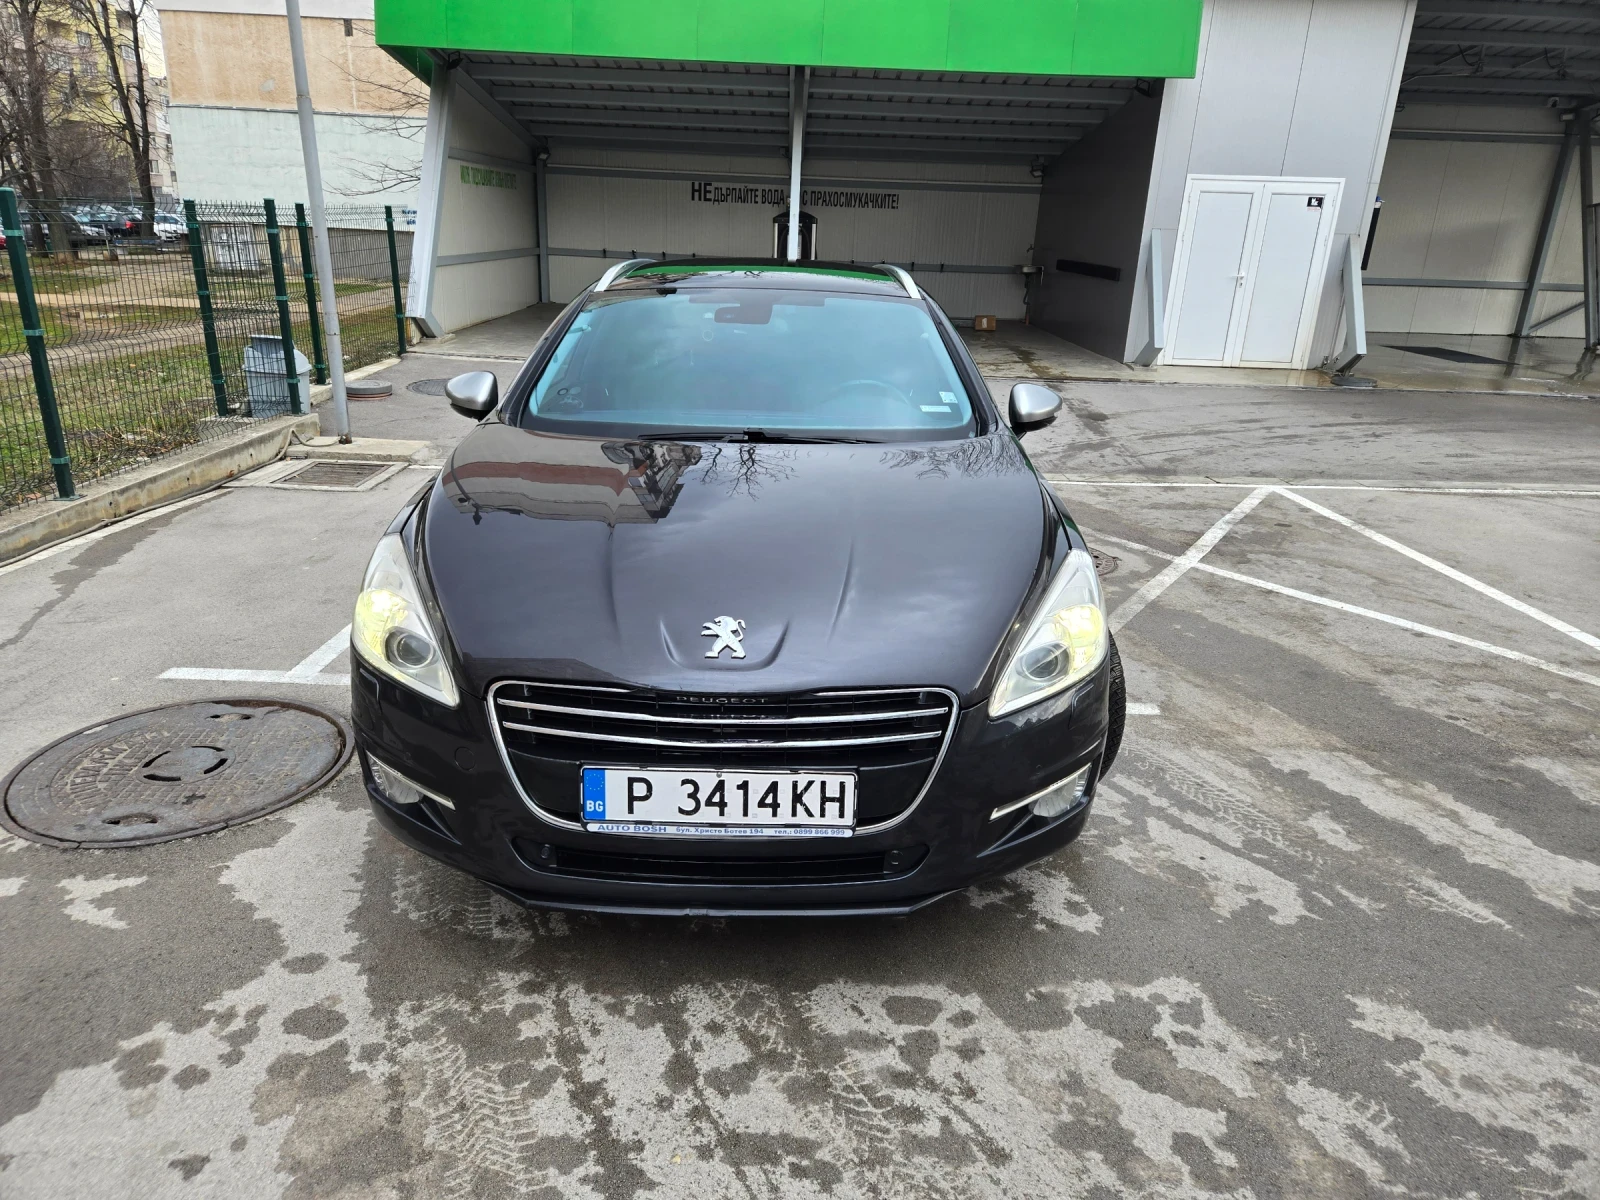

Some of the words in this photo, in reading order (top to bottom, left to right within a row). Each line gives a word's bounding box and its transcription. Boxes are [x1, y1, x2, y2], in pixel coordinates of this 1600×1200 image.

[691, 182, 712, 201] НЕ
[713, 185, 758, 205] ДЪРПАЙТЕ
[761, 189, 785, 207] ВОДА
[802, 190, 808, 205] С
[810, 190, 900, 209] ПРАХОСМУКАЧКИТЕ!
[676, 696, 768, 704] PEUGEOT
[627, 777, 653, 814] P
[586, 800, 604, 812] BG
[597, 824, 631, 832] AUTO
[633, 825, 667, 833] BOSH
[676, 826, 692, 834] бул.
[694, 827, 722, 835] Христо
